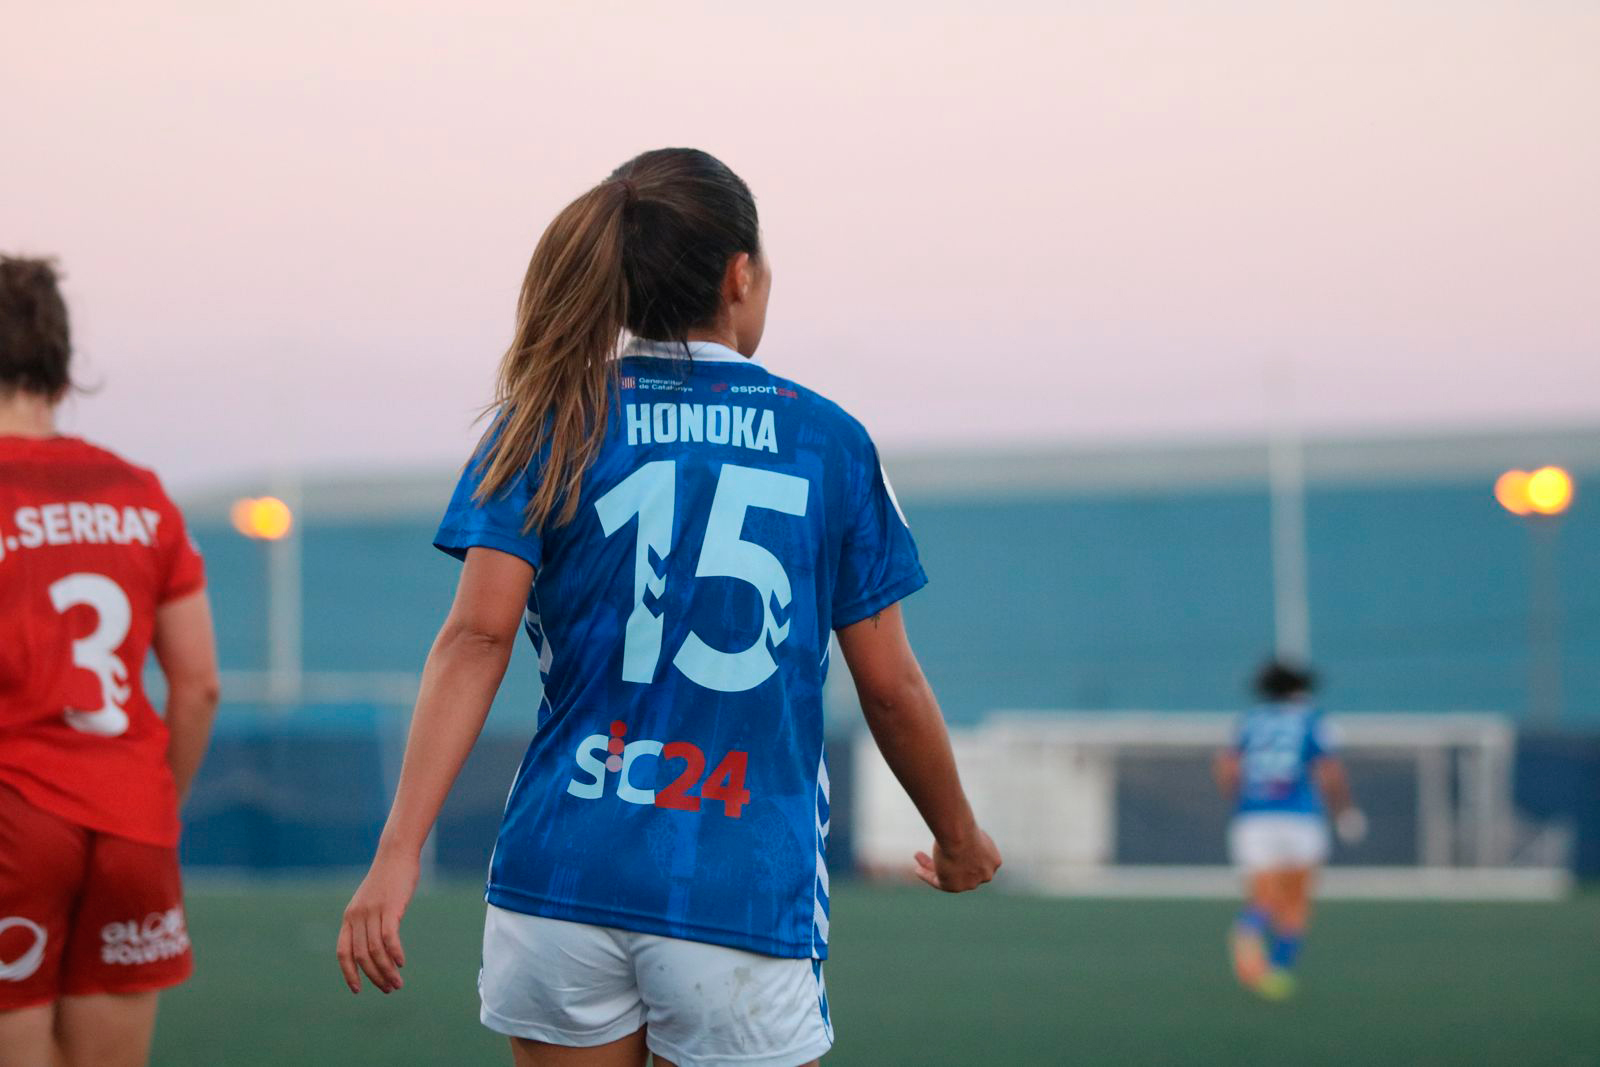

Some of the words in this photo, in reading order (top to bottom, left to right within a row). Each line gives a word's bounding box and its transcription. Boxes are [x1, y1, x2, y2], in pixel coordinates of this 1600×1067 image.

[626, 402, 779, 454] HONOKA
[48, 572, 132, 737] 3
[594, 460, 810, 692] 15
